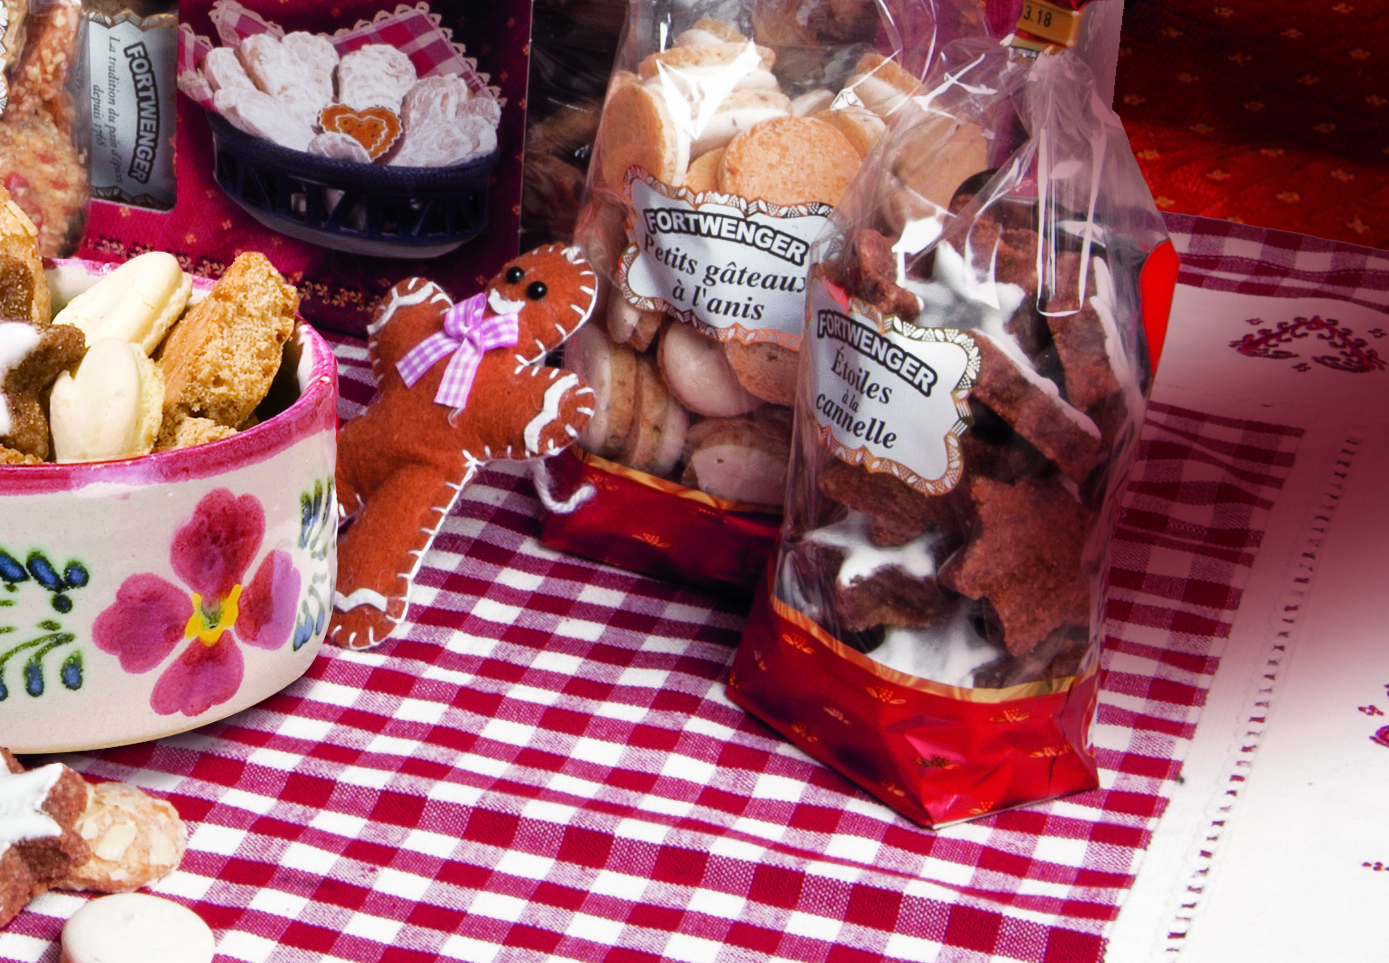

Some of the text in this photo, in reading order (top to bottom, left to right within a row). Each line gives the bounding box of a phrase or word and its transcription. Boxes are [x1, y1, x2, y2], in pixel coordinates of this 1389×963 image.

[109, 35, 121, 53] La
[91, 84, 105, 120] depuis
[108, 56, 122, 105] tradition
[108, 107, 120, 123] du
[123, 41, 161, 184] FORTWENGER
[643, 208, 809, 267] FORTWENGER
[644, 234, 698, 275] Petits
[672, 279, 765, 321] à l'anis
[817, 309, 938, 398] FORTWENGER
[831, 345, 893, 405] Étoiles
[816, 392, 897, 449] cannelle
[841, 388, 859, 413] à la
